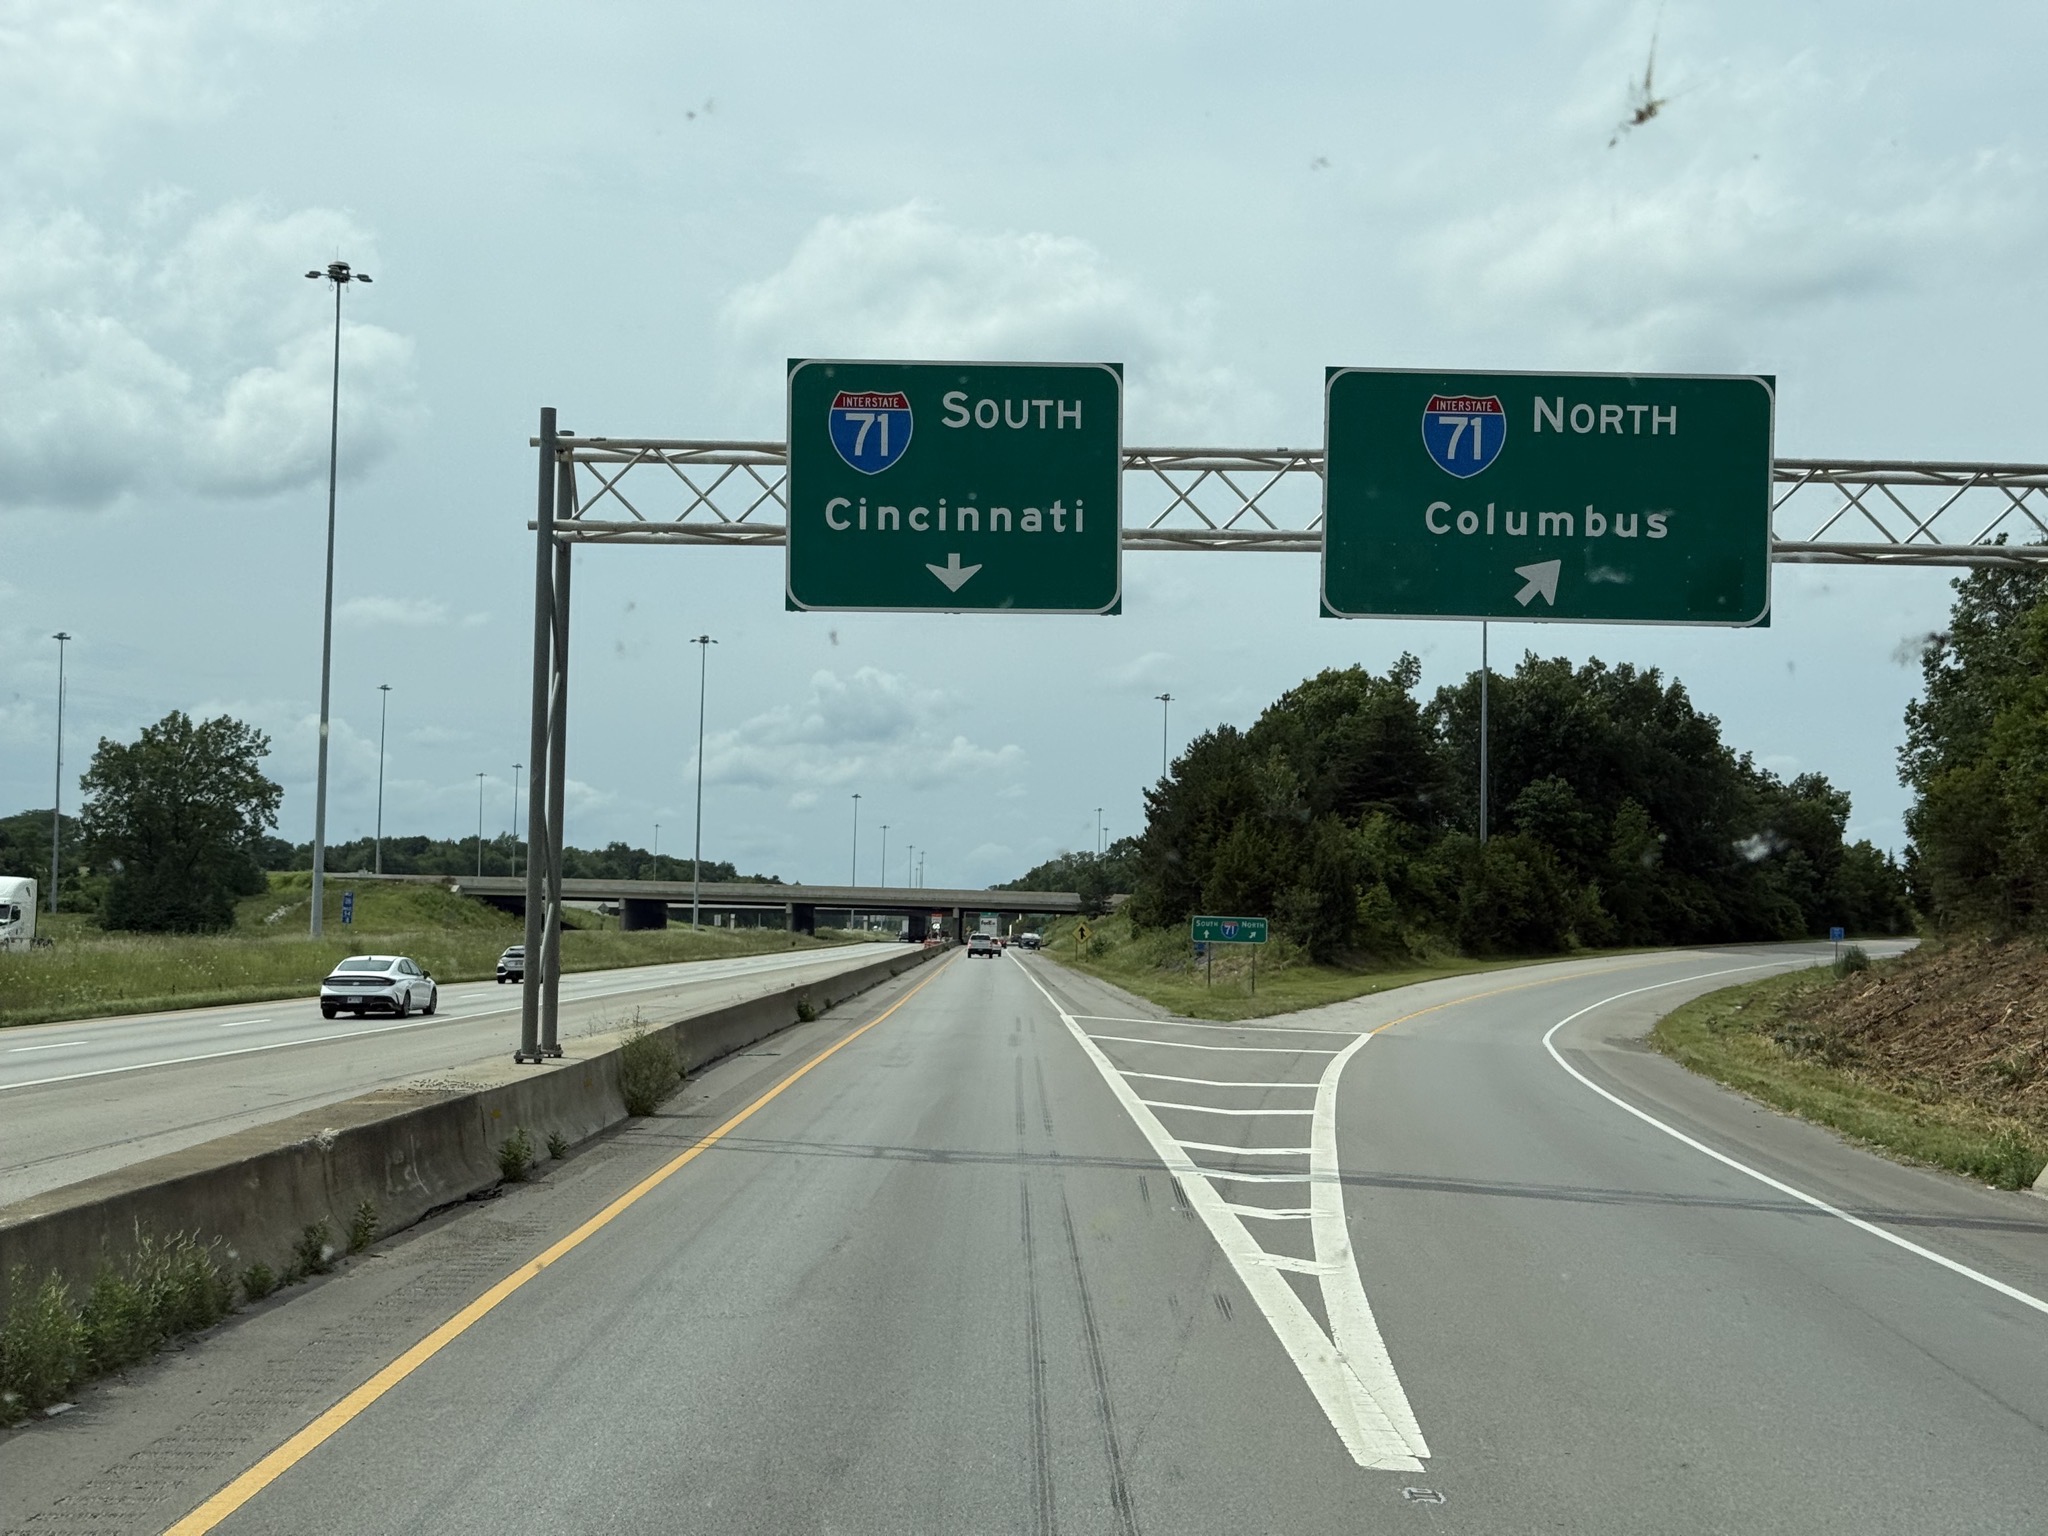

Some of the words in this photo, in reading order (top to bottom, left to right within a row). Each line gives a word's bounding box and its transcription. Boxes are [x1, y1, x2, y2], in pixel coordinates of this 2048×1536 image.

[842, 396, 900, 408] INTERSTATE
[941, 390, 1082, 430] SOUTH
[1436, 400, 1493, 412] INTERSTATE
[1533, 396, 1677, 435] NORTH
[845, 412, 889, 456] 71
[1438, 416, 1482, 460] 71
[825, 497, 1084, 533] Cincinnati
[1425, 501, 1669, 539] Columbus
[1224, 925, 1235, 935] 71
[1241, 920, 1265, 929] NORTH
